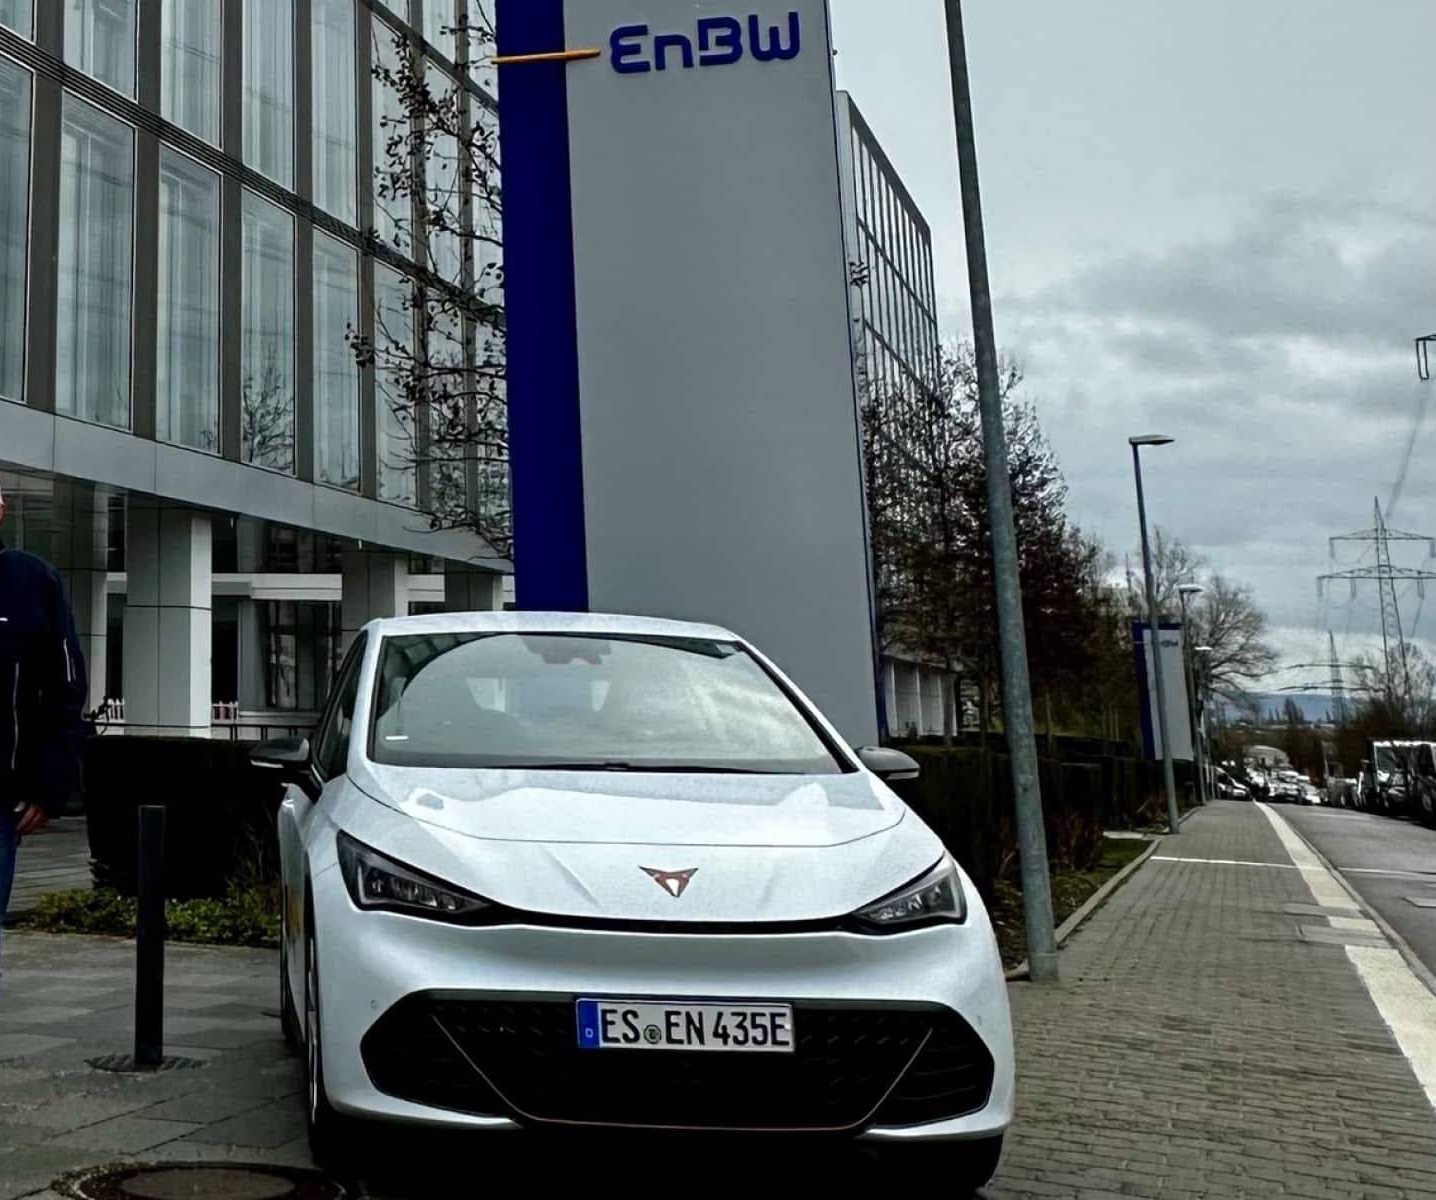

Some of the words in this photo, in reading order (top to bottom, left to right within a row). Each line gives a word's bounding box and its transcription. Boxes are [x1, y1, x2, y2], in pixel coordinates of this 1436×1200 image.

[609, 11, 802, 75] EnBW
[600, 1009, 641, 1045] ES
[664, 1010, 705, 1046] EN
[712, 1011, 790, 1047] 435E
